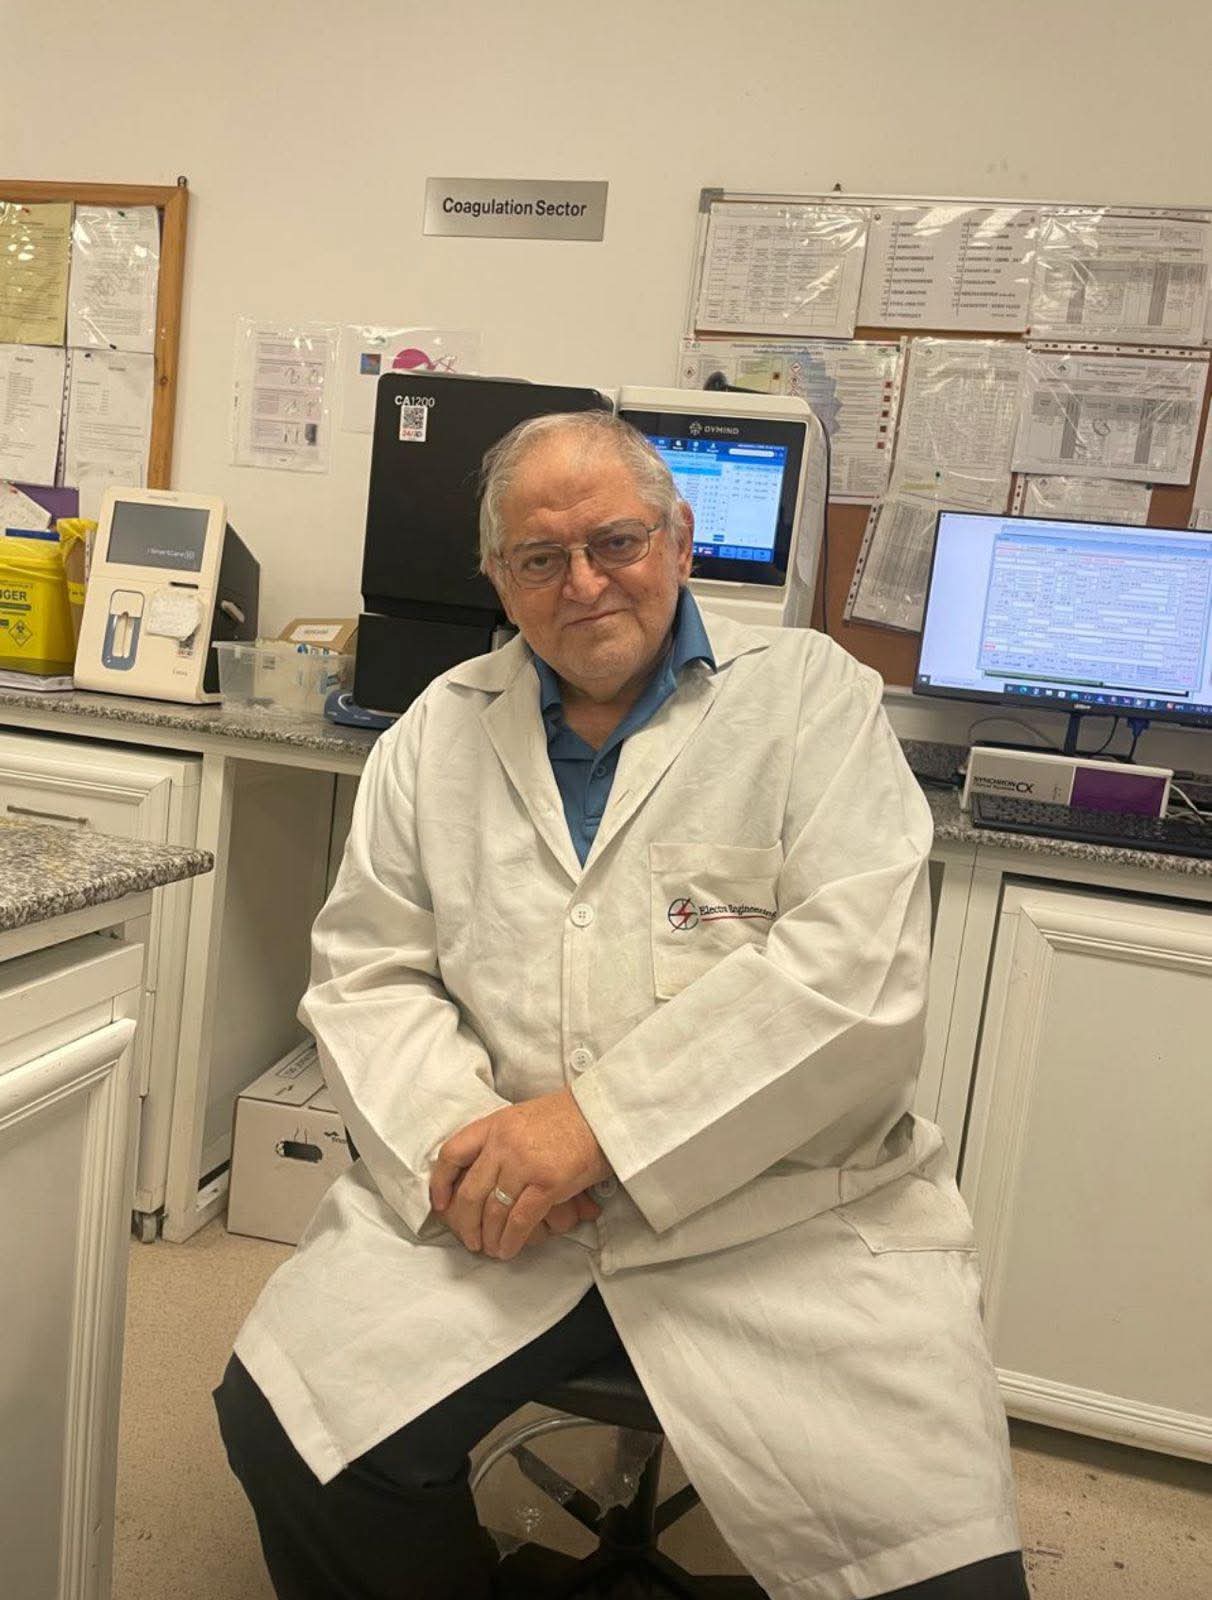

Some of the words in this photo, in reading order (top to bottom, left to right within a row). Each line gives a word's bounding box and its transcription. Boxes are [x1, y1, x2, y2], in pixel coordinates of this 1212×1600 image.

[442, 197, 533, 218] Coagulation
[535, 200, 587, 217] Sector
[394, 395, 436, 408] CA1200
[0, 589, 27, 601] GER
[1016, 782, 1035, 794] CX
